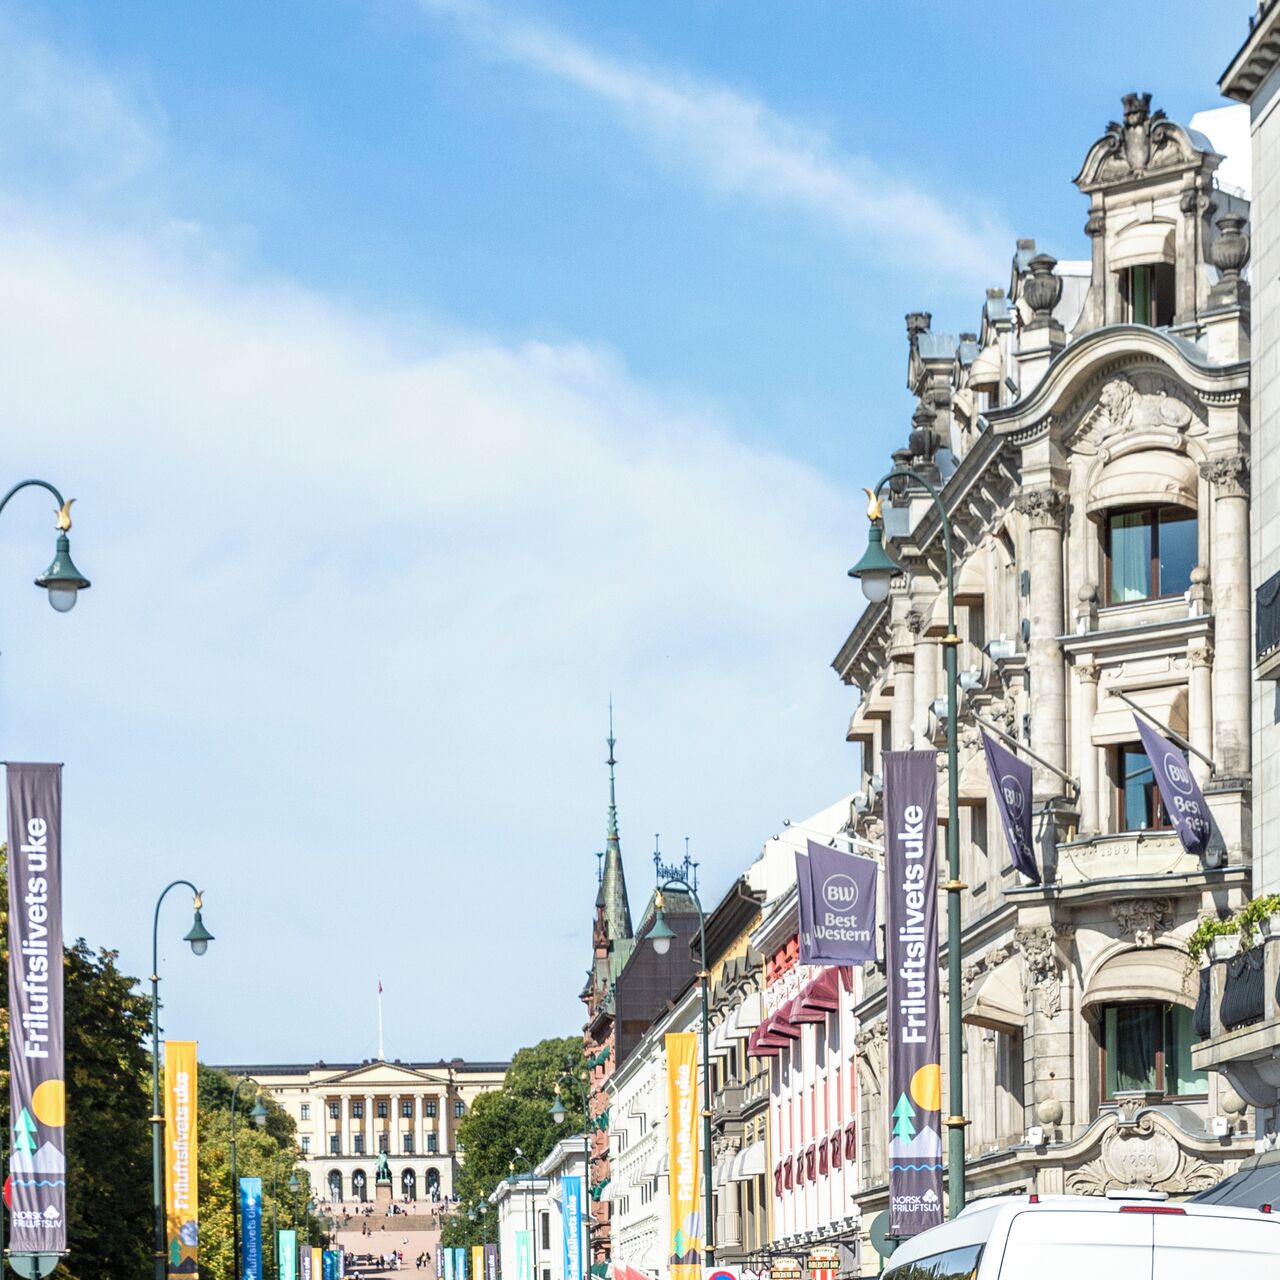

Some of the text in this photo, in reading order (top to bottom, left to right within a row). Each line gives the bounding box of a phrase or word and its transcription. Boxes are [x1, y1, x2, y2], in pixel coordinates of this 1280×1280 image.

[827, 886, 854, 902] BW
[824, 912, 857, 928] Best
[898, 805, 926, 1044] Friluftslivets uke
[20, 817, 48, 1058] Friluftslivets uke
[813, 925, 870, 942] Western
[674, 1063, 693, 1201] Friluftslivets uke
[172, 1071, 189, 1210] Friluftslivets uke
[892, 1195, 921, 1204] NORSK
[13, 1211, 43, 1219] NORSK
[892, 1204, 941, 1212] FRILUFTSLIV
[13, 1219, 62, 1228] FRILUFTSLIV
